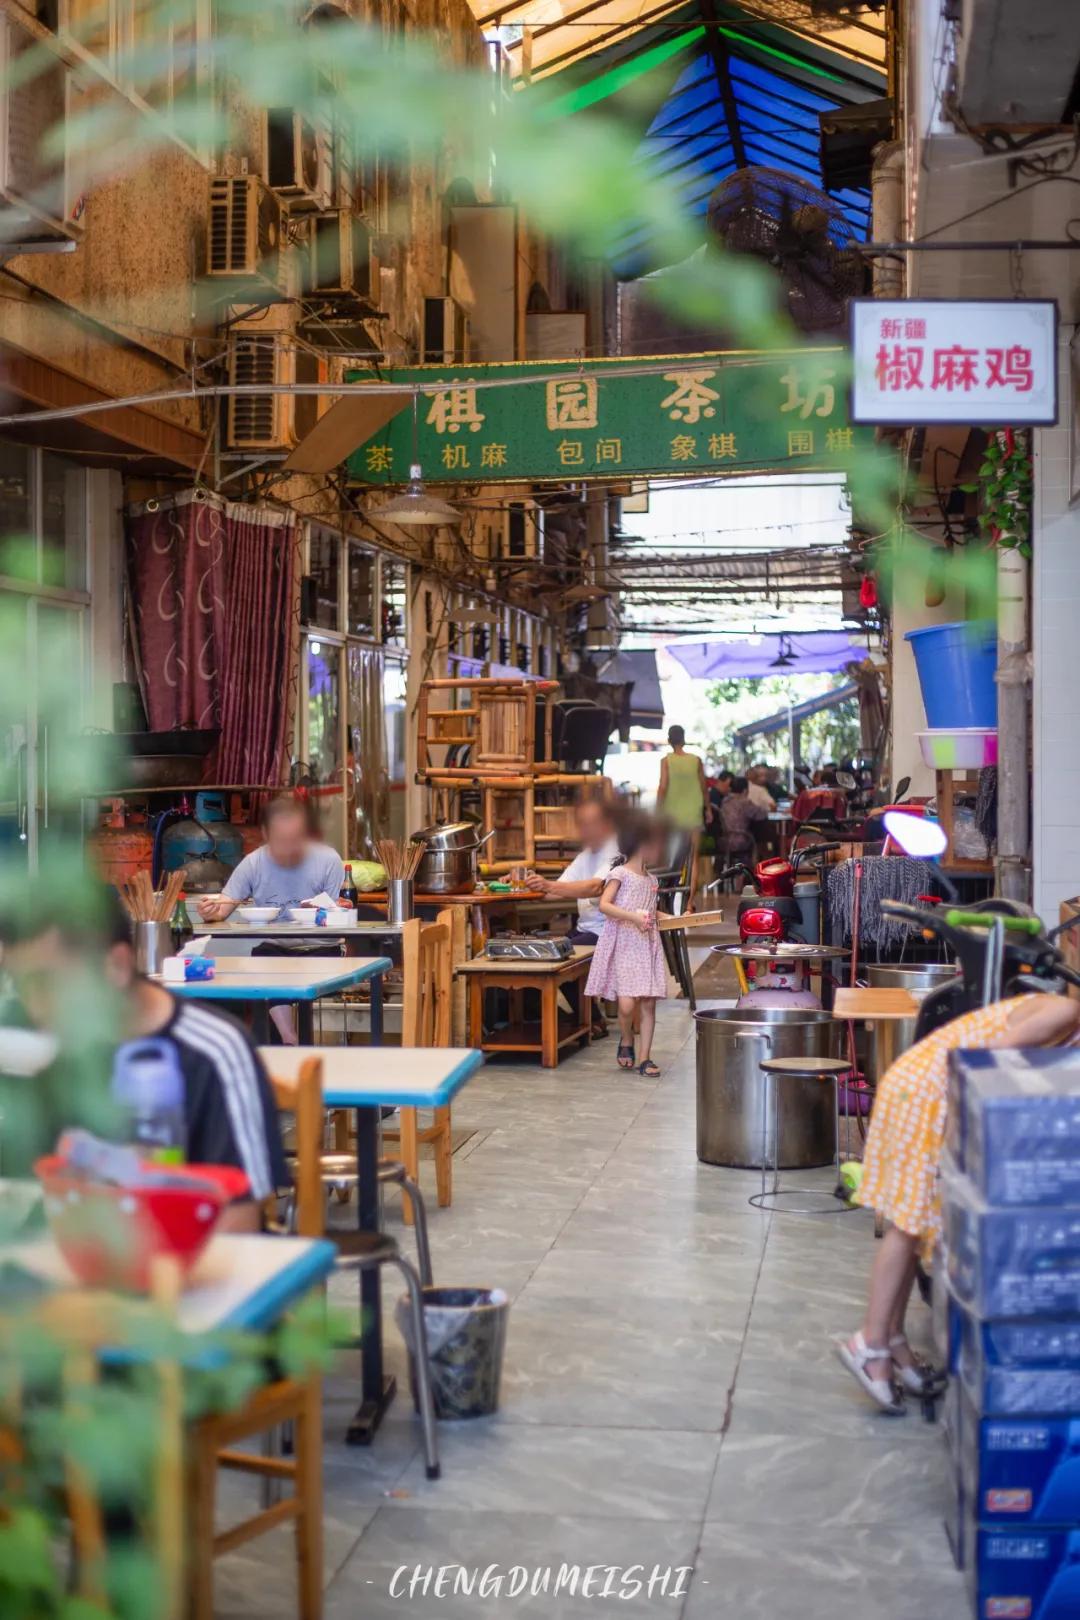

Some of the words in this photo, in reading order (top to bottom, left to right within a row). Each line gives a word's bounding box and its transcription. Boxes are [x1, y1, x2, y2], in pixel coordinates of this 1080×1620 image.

[880, 317, 927, 340] 新疆
[874, 344, 1034, 392] 椒麻鸡
[442, 443, 508, 469] 机麻
[557, 438, 623, 465] 包间
[670, 432, 738, 461] 象棋
[788, 427, 855, 456] 围棋
